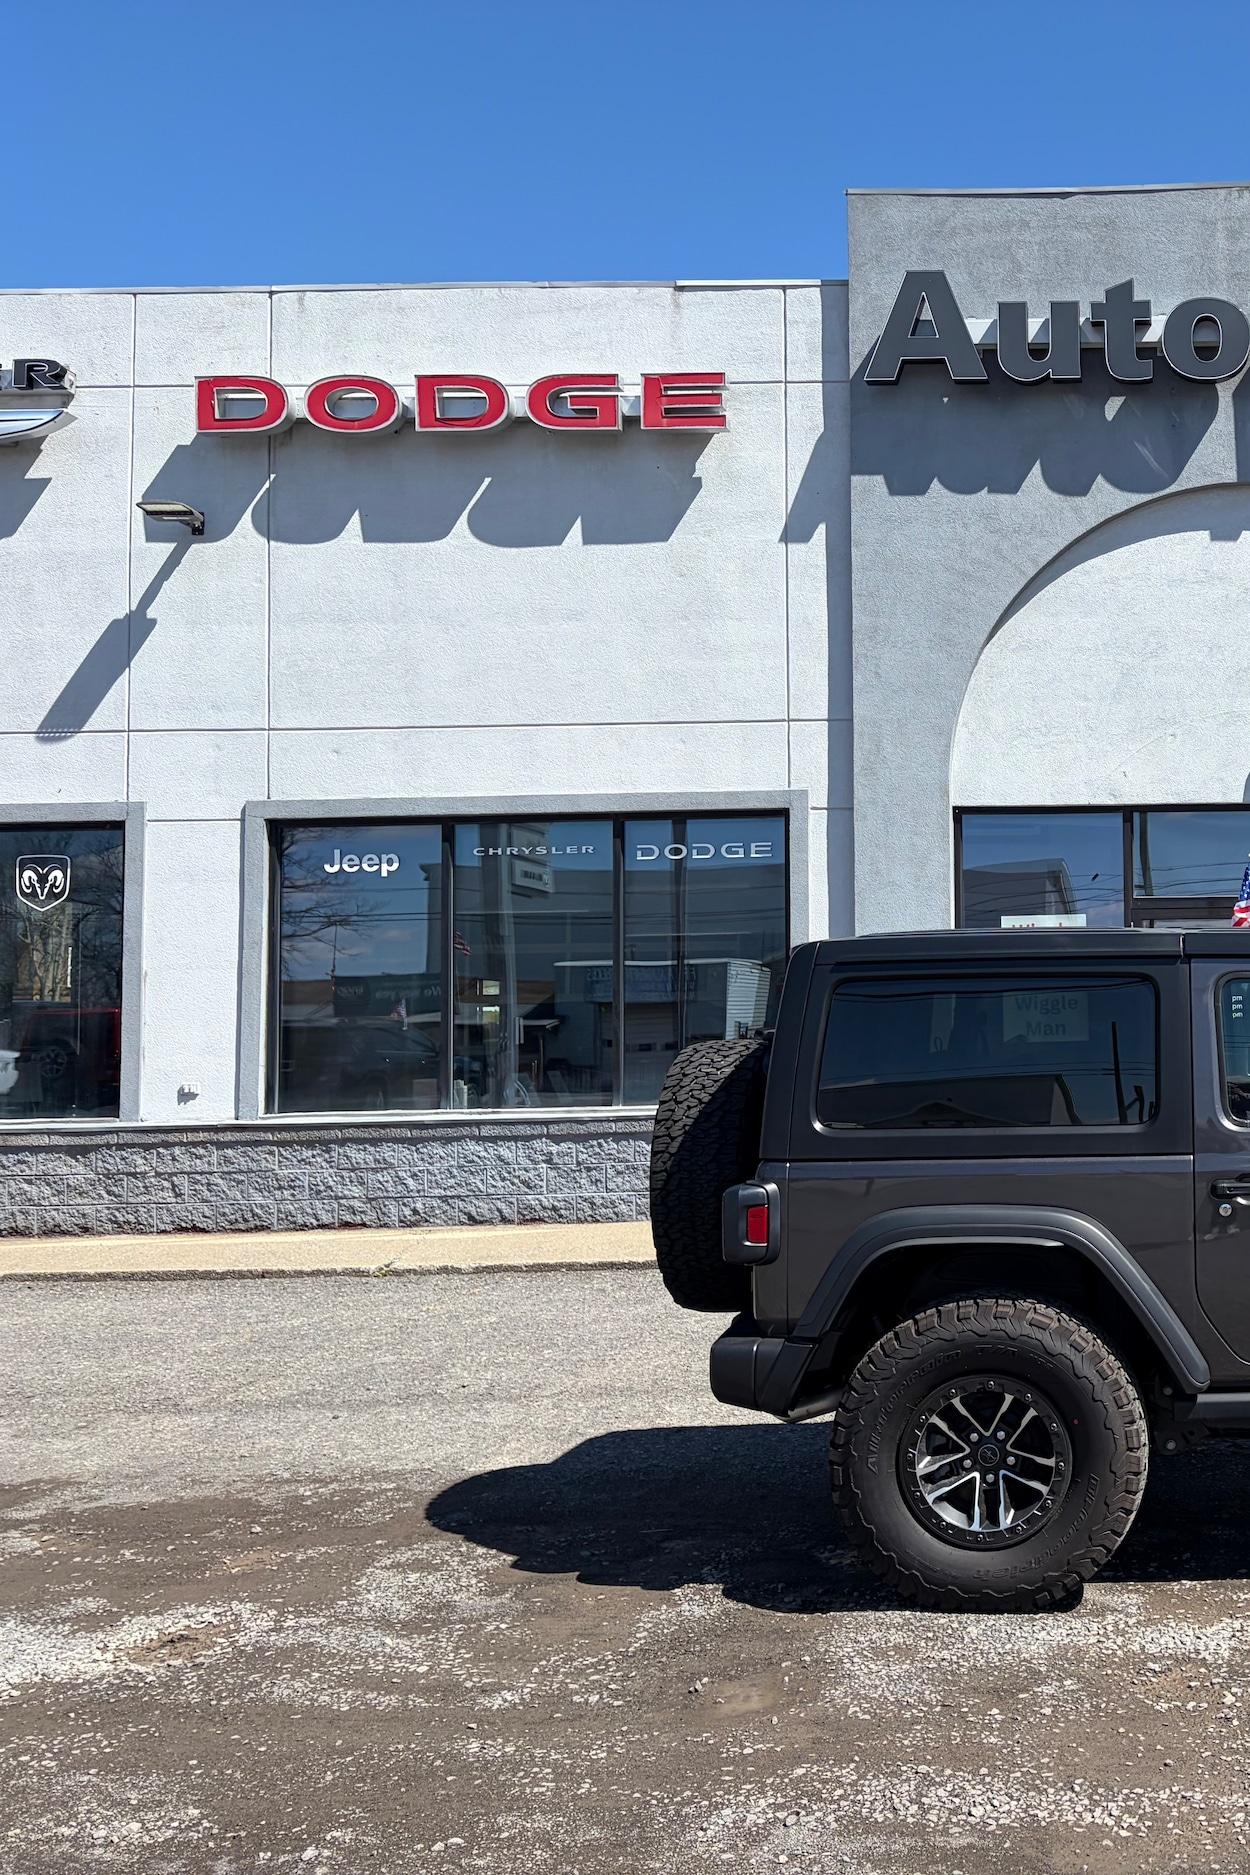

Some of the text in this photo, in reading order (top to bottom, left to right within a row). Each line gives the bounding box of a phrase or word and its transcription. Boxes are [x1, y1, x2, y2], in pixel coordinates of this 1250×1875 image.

[863, 269, 1250, 383] Auto
[0, 358, 68, 391] R
[195, 372, 728, 433] DODGE
[472, 845, 595, 856] CHRYSLER
[636, 842, 773, 860] DODGE
[323, 849, 399, 877] Jeep
[1015, 996, 1078, 1015] Wiggle
[1231, 994, 1243, 1002] pm
[1231, 1011, 1243, 1019] pm
[1026, 1021, 1066, 1036] Man
